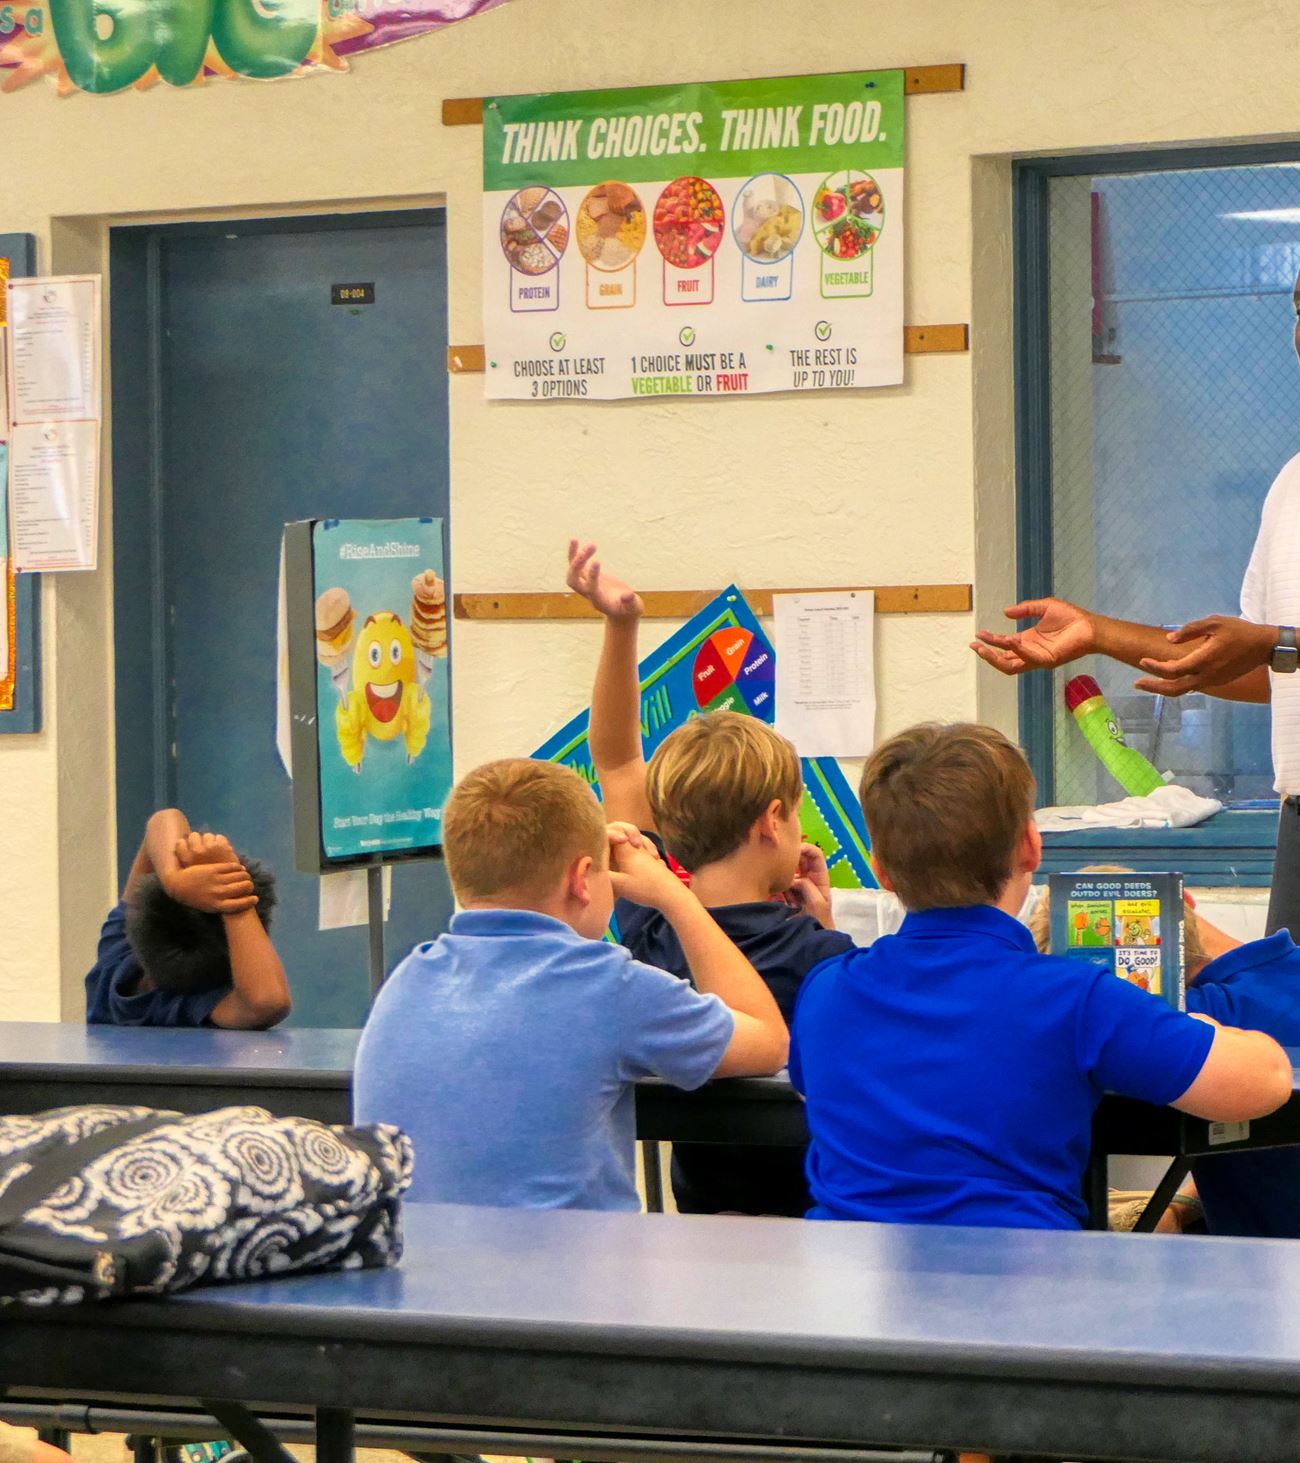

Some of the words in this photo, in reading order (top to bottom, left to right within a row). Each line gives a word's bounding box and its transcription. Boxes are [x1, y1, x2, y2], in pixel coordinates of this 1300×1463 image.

[24, 7, 45, 35] a
[502, 120, 583, 164] THINK
[587, 112, 707, 160] CHOICES.
[720, 106, 803, 151] THINK
[809, 100, 886, 146] FOOD.
[677, 280, 699, 292] FRUIT
[756, 275, 778, 288] DAIRY
[825, 272, 868, 285] VEGETABLE
[518, 287, 550, 299] PROTEIN
[631, 357, 636, 373] 1
[641, 355, 681, 372] CHOICE
[685, 353, 717, 371] MUST
[720, 353, 735, 369] BE
[739, 352, 746, 369] A
[790, 350, 811, 367] THE
[815, 349, 842, 365] REST
[846, 348, 857, 365] IS
[513, 359, 555, 377] CHOOSE
[558, 359, 570, 375] AT
[573, 358, 605, 375] LEAST
[632, 376, 692, 394] VEGETABLE
[696, 375, 712, 392] OR
[716, 373, 748, 391] FRUIT
[793, 371, 808, 387] UP
[812, 370, 825, 387] TO
[830, 370, 855, 386] YOU!
[531, 380, 538, 397] 3
[542, 379, 588, 397] OPTIONS
[726, 638, 745, 656] Grain
[697, 664, 716, 682] Fruit
[744, 653, 768, 676] Protein
[753, 691, 769, 706] Milk
[1118, 956, 1130, 965] DO
[1134, 956, 1158, 965] GOOD!
